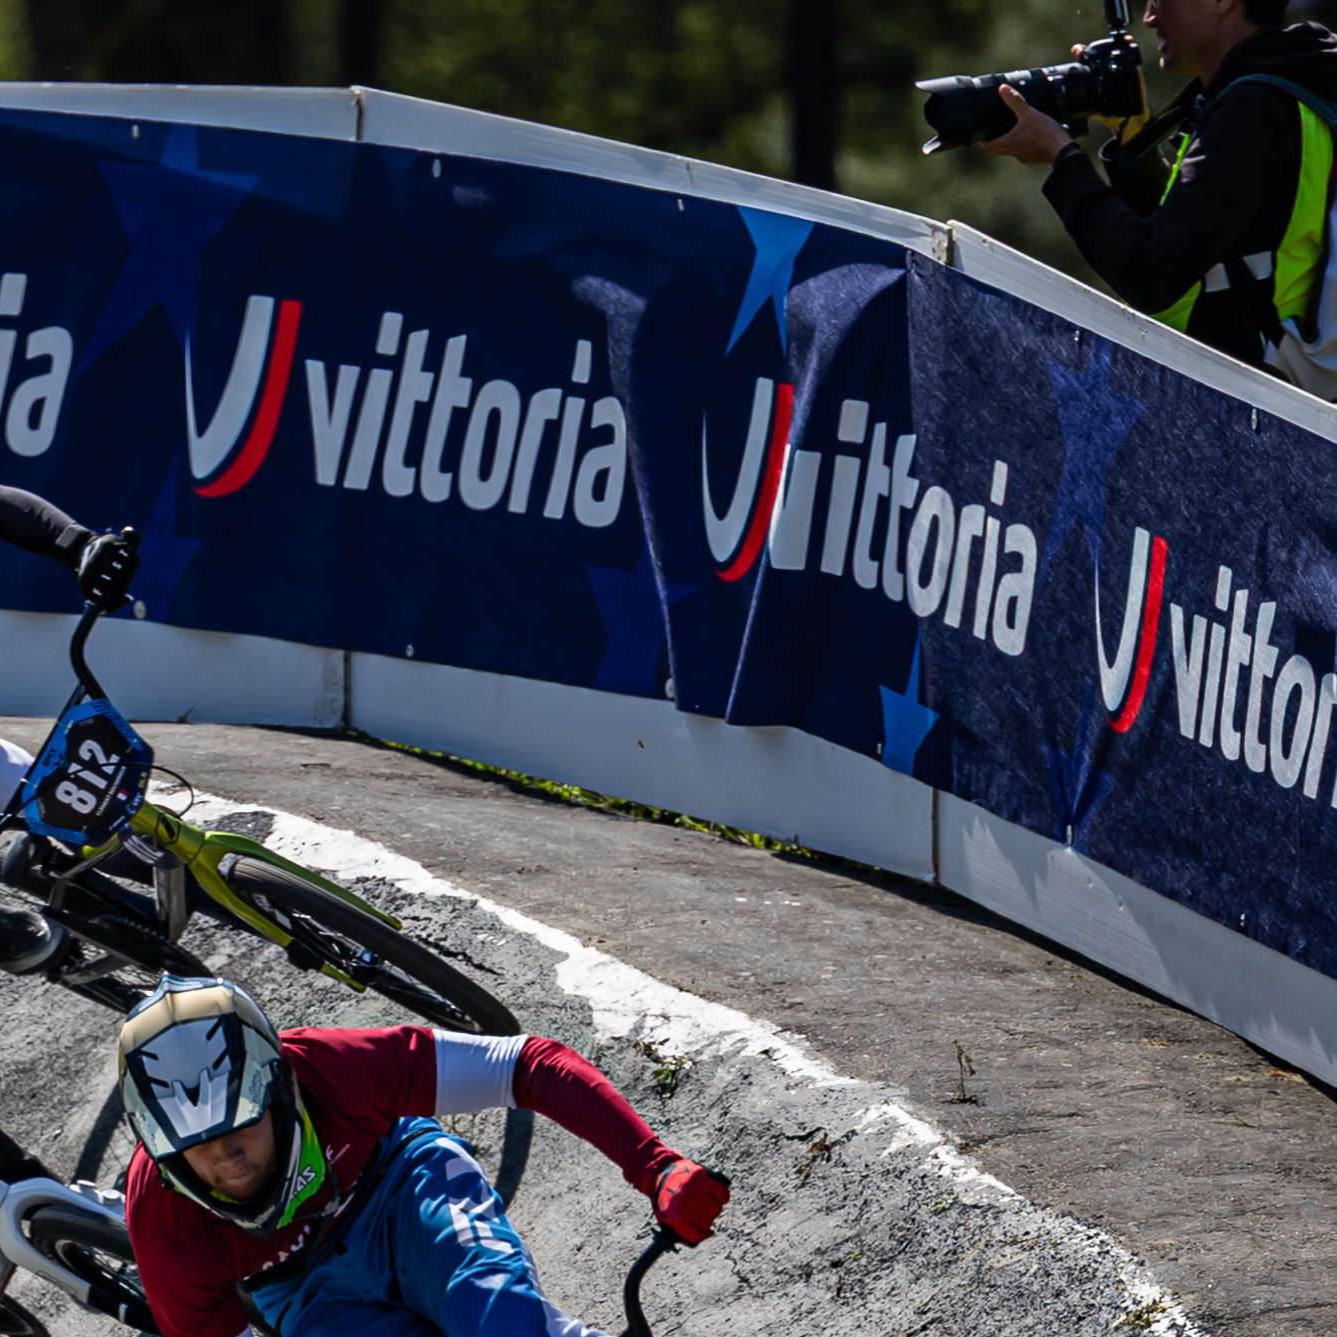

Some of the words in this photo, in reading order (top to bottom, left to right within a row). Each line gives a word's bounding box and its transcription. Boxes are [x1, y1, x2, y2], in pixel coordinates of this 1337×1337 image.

[305, 311, 626, 527] vittoria
[92, 548, 130, 596] FIST
[769, 399, 1037, 656] vittoria
[55, 738, 121, 816] 812
[1170, 565, 1337, 809] vittor
